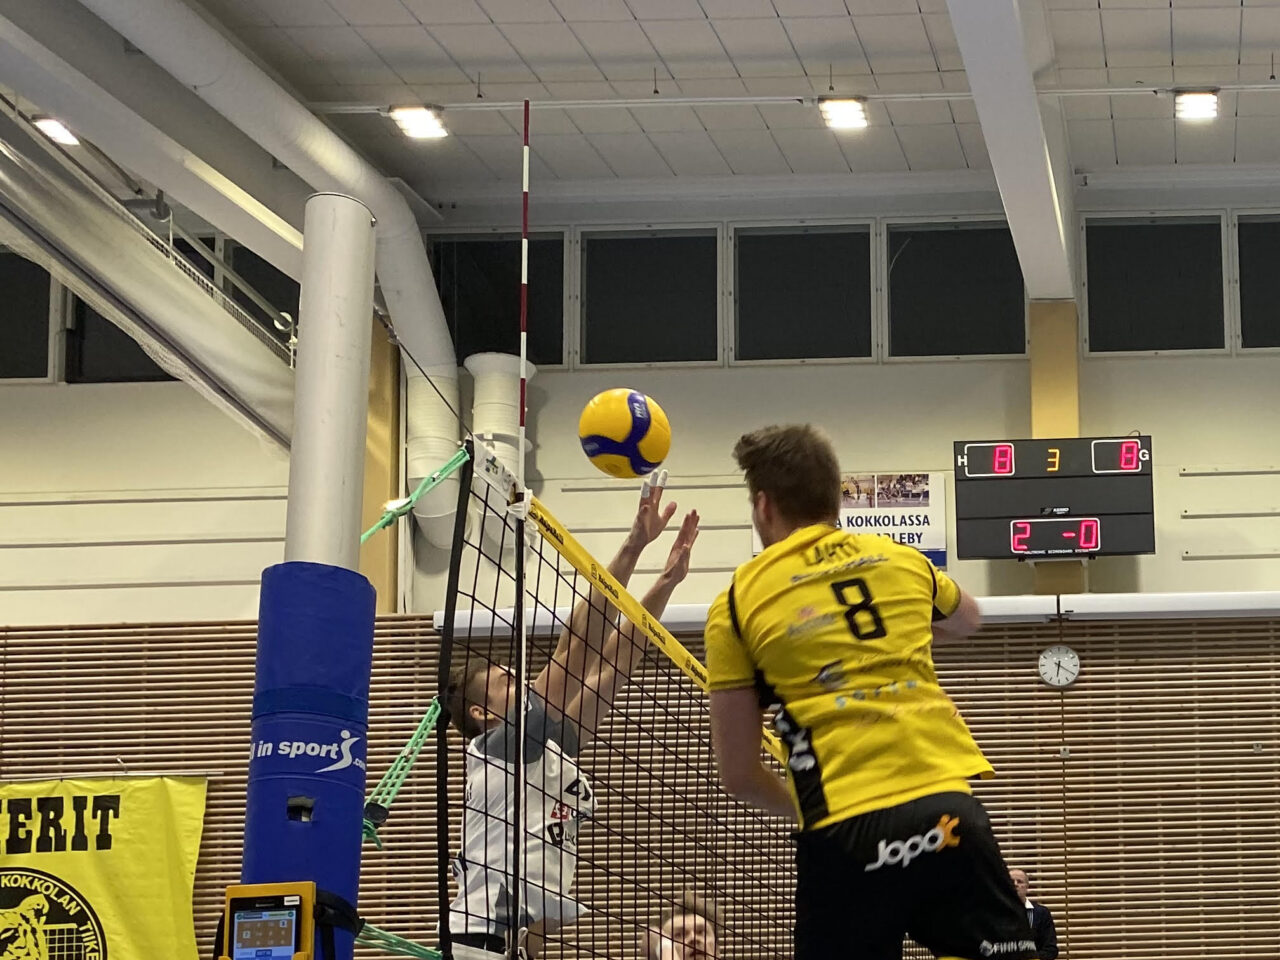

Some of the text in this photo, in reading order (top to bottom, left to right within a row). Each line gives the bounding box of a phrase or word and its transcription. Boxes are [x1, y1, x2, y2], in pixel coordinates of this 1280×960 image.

[957, 442, 1150, 473] H 8 3 8 G
[846, 514, 930, 527] KOKKOLASSA
[1012, 522, 1031, 550] 2
[831, 577, 887, 640] 8
[257, 741, 273, 757] in
[0, 795, 121, 854] ERIT
[0, 874, 81, 917] KOKKOLAN
